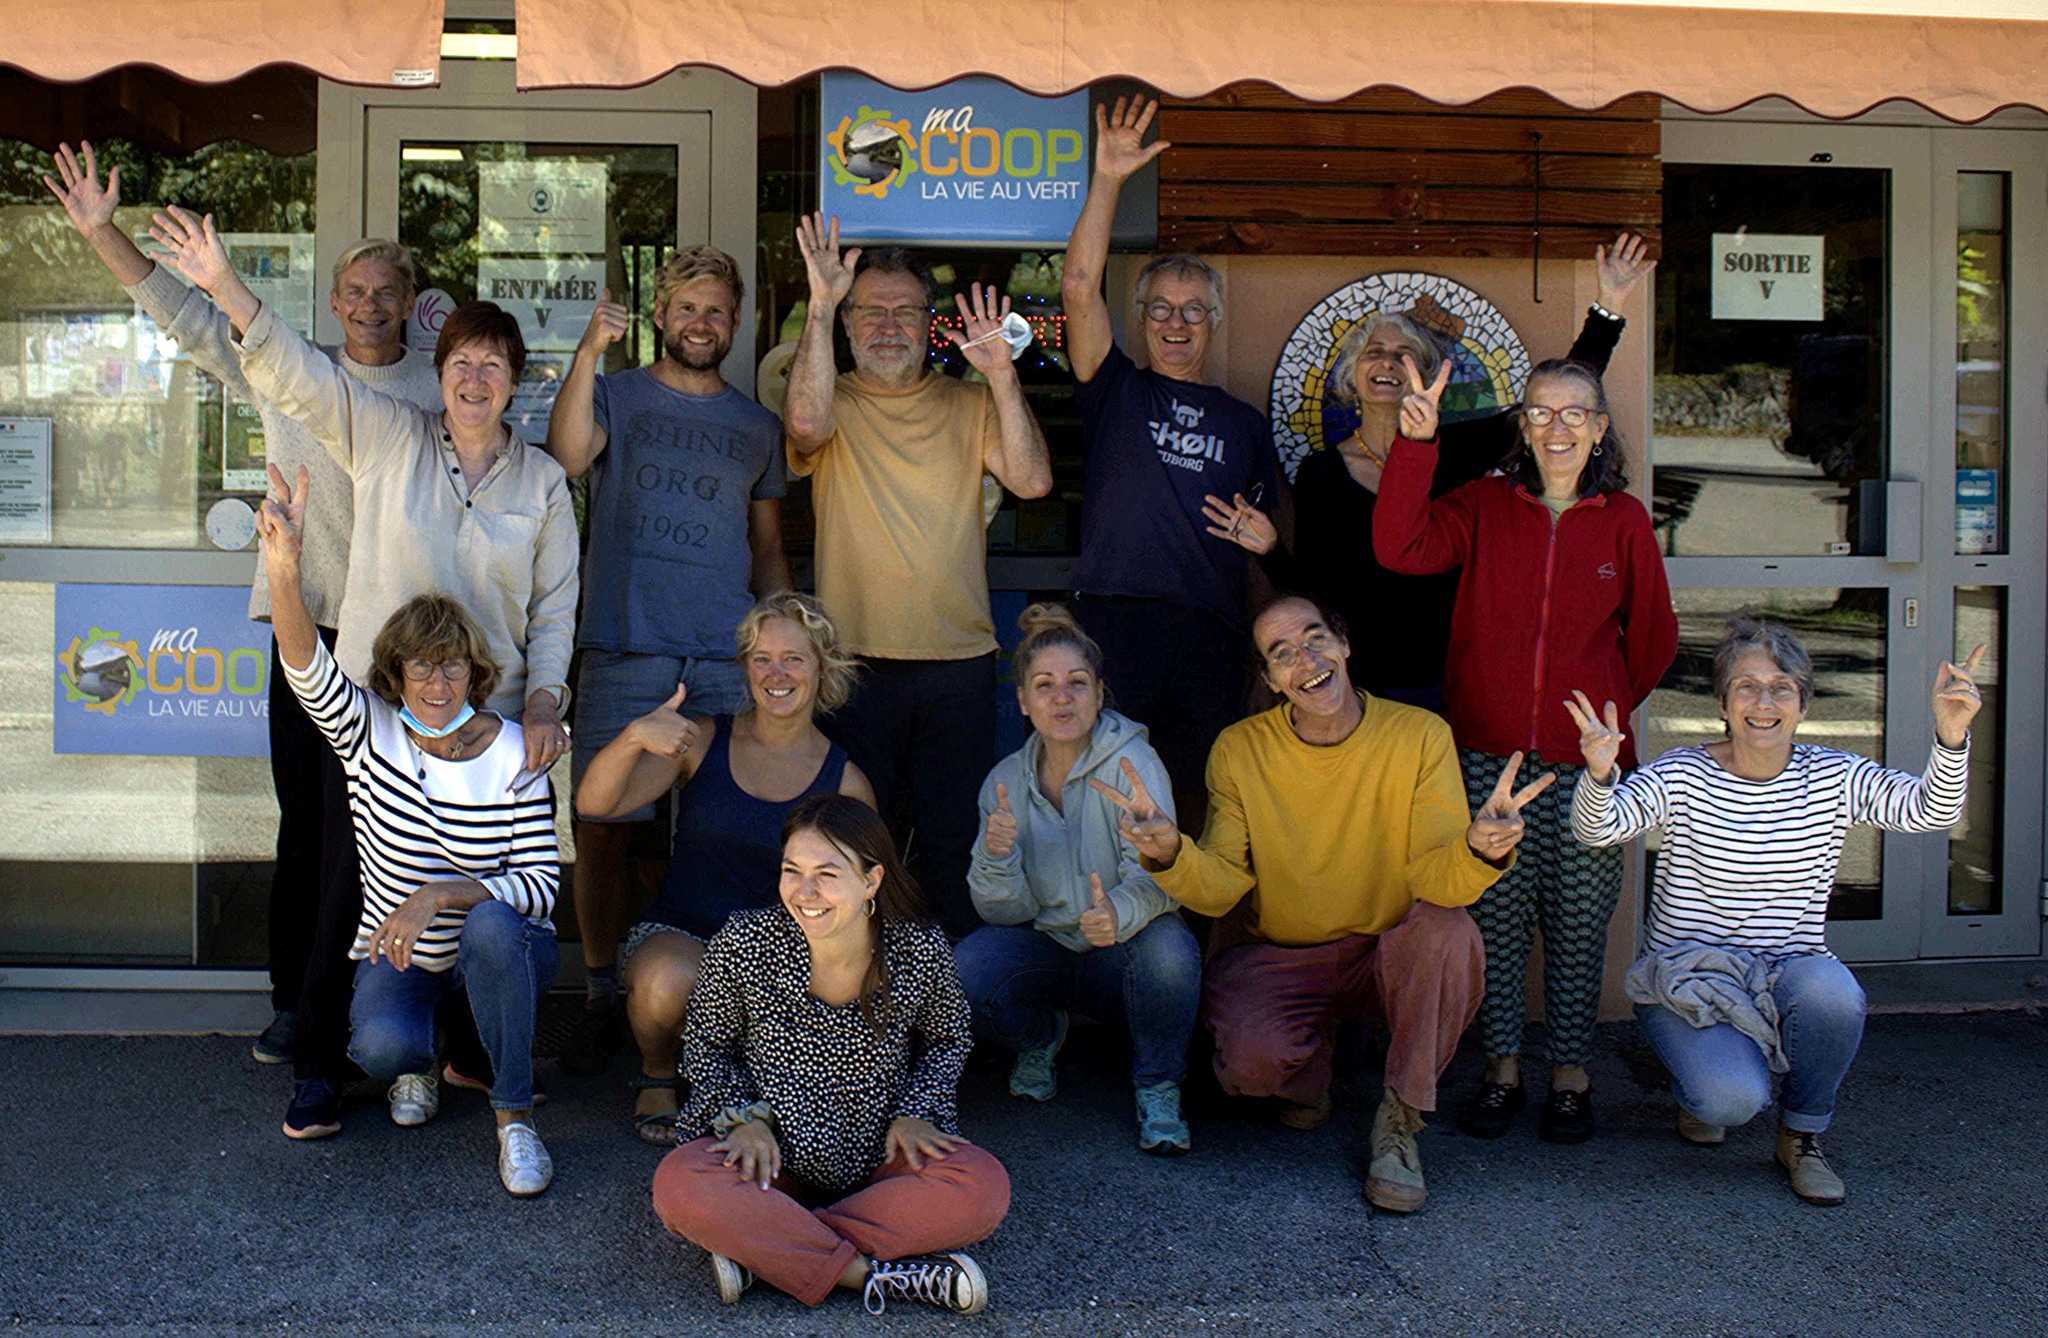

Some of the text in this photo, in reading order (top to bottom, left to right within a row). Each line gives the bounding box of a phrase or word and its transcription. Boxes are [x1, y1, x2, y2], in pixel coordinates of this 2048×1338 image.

[921, 105, 974, 134] ma
[919, 126, 1084, 178] COOP
[921, 181, 1080, 200] LA VIE AU VERT
[1723, 252, 1812, 274] SORTIE
[490, 275, 598, 301] ENTRÉE
[631, 414, 749, 464] SHINE
[637, 514, 710, 548] 1962
[148, 626, 199, 654] ma
[147, 647, 266, 696] COO
[149, 699, 270, 718] LA VIE AU VE
